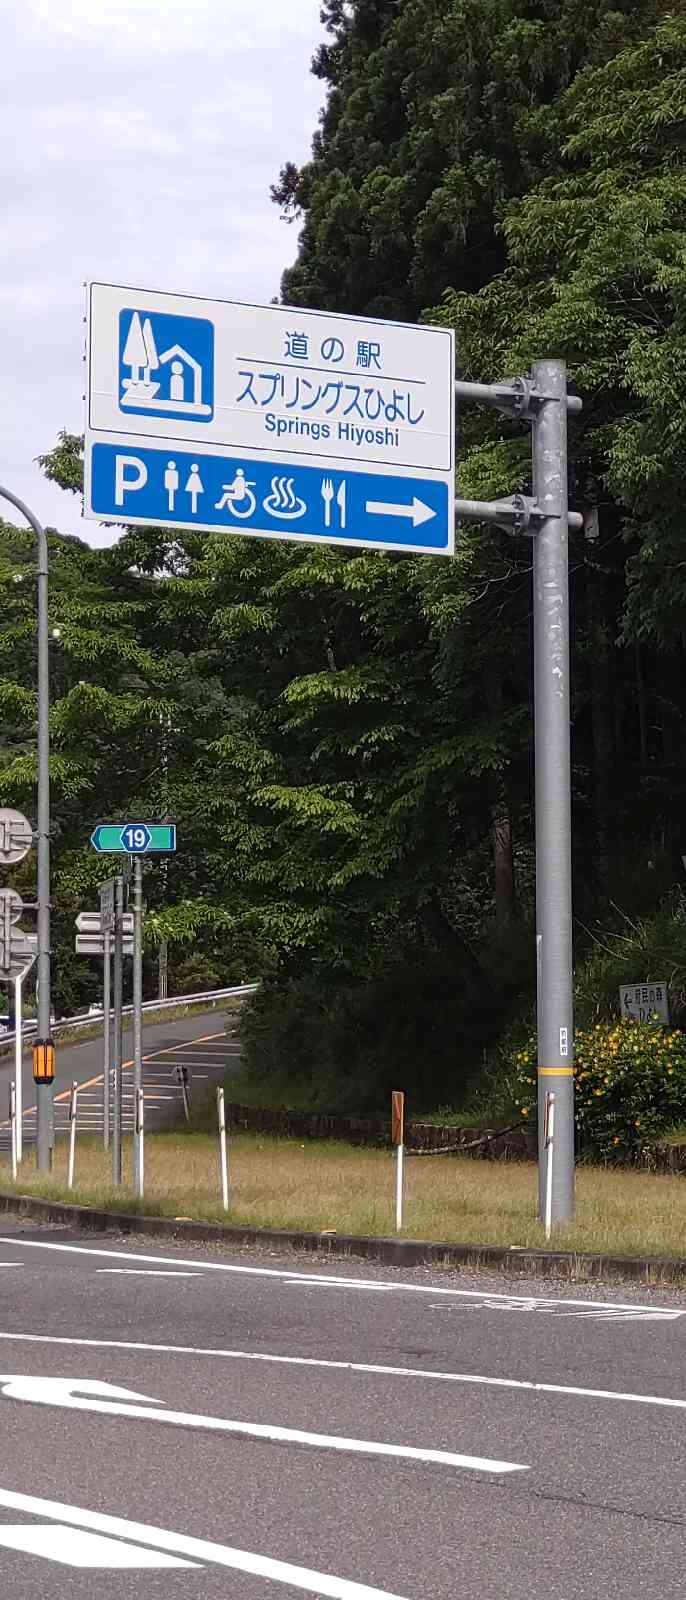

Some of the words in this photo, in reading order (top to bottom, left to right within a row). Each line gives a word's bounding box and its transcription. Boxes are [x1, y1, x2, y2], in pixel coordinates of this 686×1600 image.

[284, 331, 382, 370] 道の駅
[236, 370, 425, 425] スプリングスひよし
[264, 413, 330, 440] Springs
[338, 421, 399, 447] Hiyoshi
[115, 454, 148, 507] P
[125, 828, 146, 848] 19
